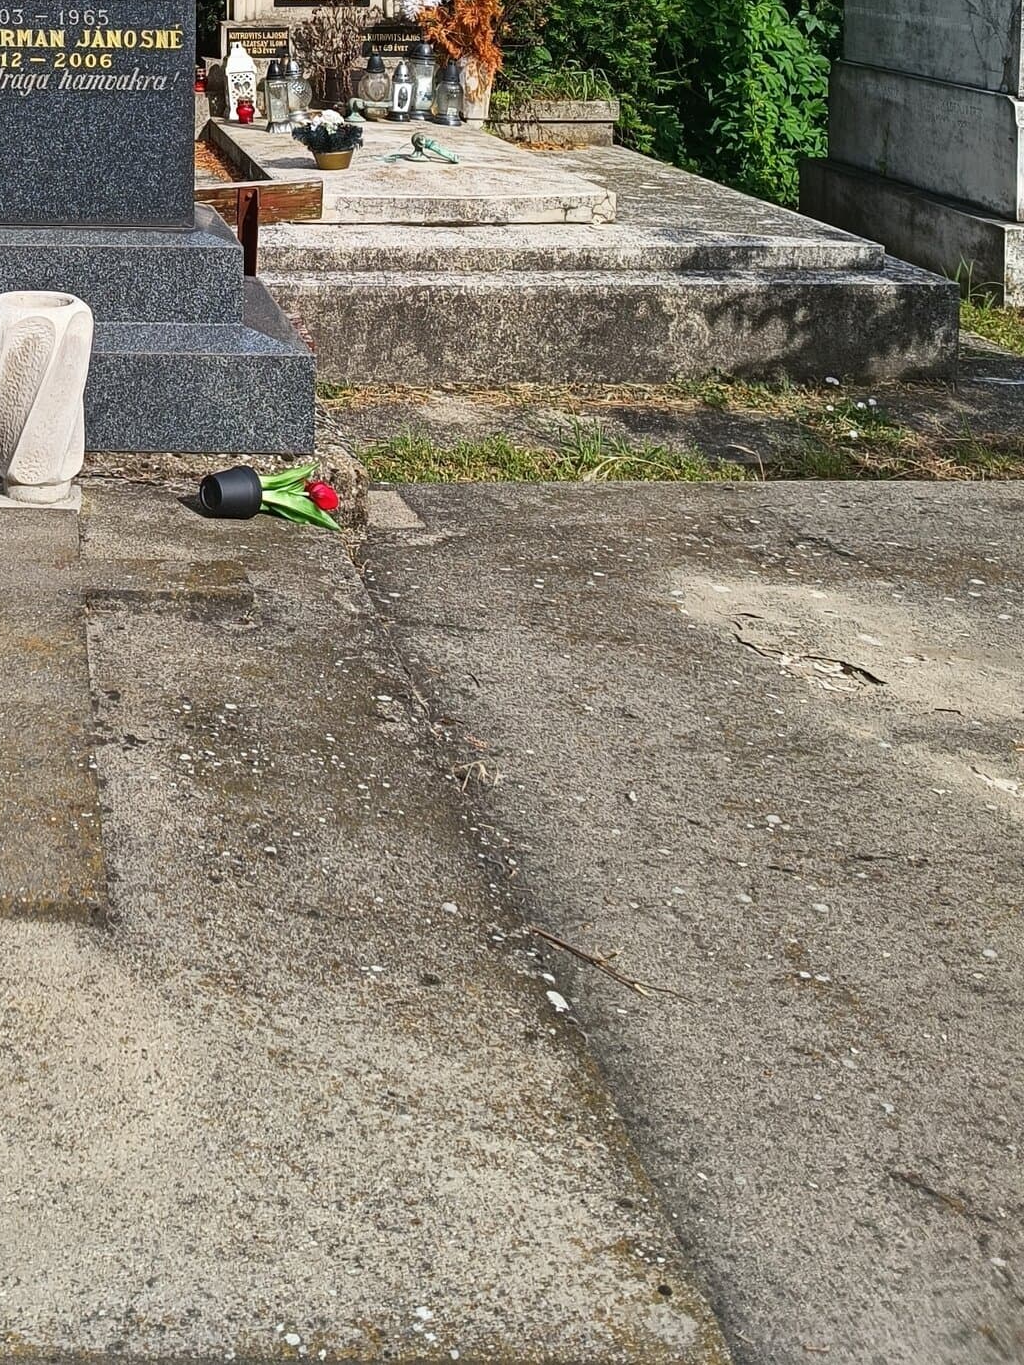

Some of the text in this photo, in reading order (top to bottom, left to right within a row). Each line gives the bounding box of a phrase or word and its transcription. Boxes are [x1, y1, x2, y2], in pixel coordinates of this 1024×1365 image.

[59, 8, 109, 26] 1965
[76, 24, 183, 49] JÁNOSNÉ
[54, 52, 113, 68] 2006
[58, 67, 179, 92] hamvakra!
